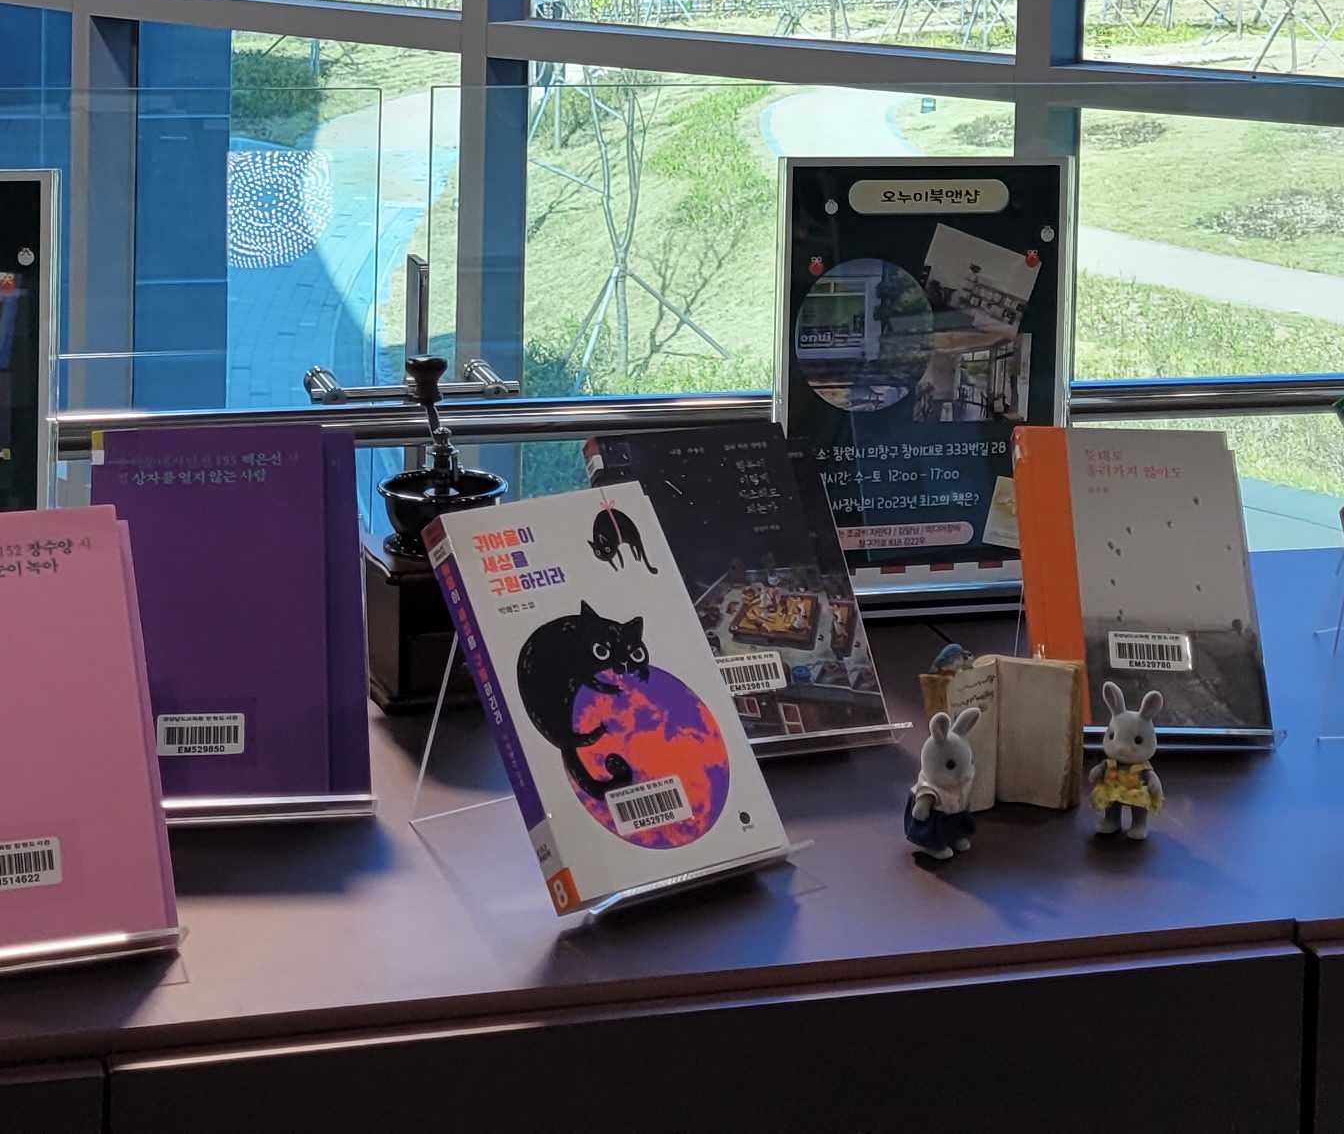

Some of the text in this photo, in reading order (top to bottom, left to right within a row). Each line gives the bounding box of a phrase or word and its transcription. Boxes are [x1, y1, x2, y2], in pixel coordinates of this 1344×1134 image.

[880, 188, 981, 204] 오누이북앤샵
[833, 446, 865, 460] 창원시
[867, 445, 899, 459] 의창구
[902, 443, 943, 459] 창이대로
[946, 441, 989, 457] 333번길
[991, 441, 1006, 454] 28
[132, 470, 175, 486] 상자를
[888, 469, 917, 482] 12:00
[930, 468, 960, 480] 17:00
[1144, 466, 1184, 480] 않아도
[832, 492, 980, 512] 사장님의 2023년 최고의 책은?
[29, 537, 74, 558] 장수양
[472, 526, 535, 552] 귀여움이
[26, 558, 59, 575] 녹아
[481, 550, 529, 574] 세상을
[488, 566, 566, 596] 구원하리라
[177, 745, 225, 754] EM529850
[633, 811, 675, 830] EM529766
[551, 879, 568, 909] 8
